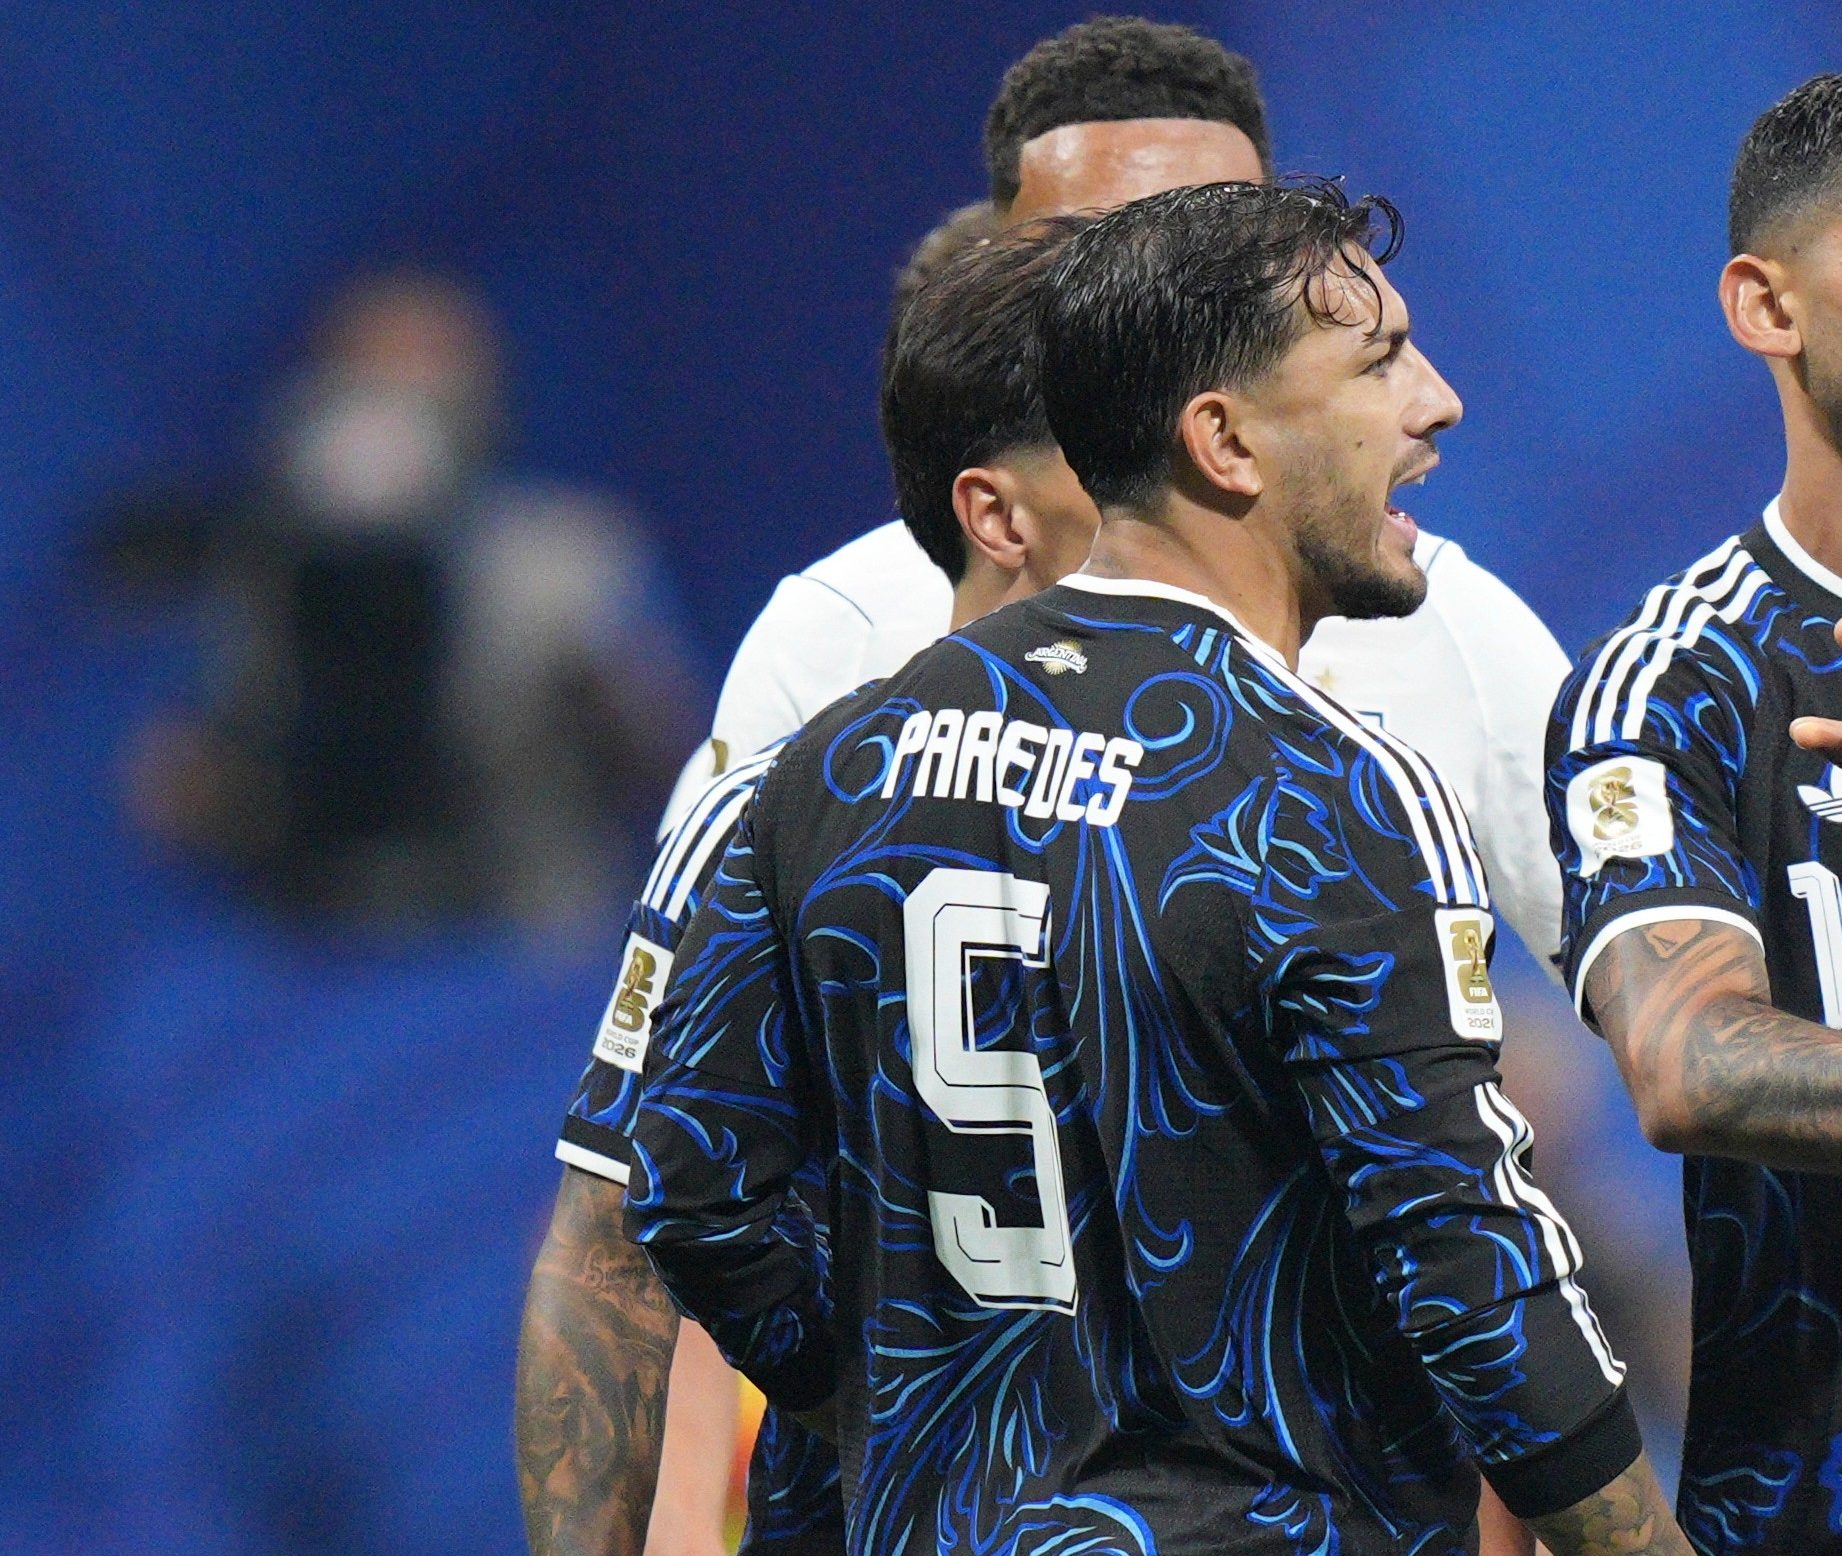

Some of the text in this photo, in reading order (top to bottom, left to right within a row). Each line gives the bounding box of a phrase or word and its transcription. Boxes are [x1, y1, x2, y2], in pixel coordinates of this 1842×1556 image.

[1032, 645, 1088, 668] ARGENTINA
[880, 708, 1146, 827] PAREDES
[903, 866, 1076, 1316] 5
